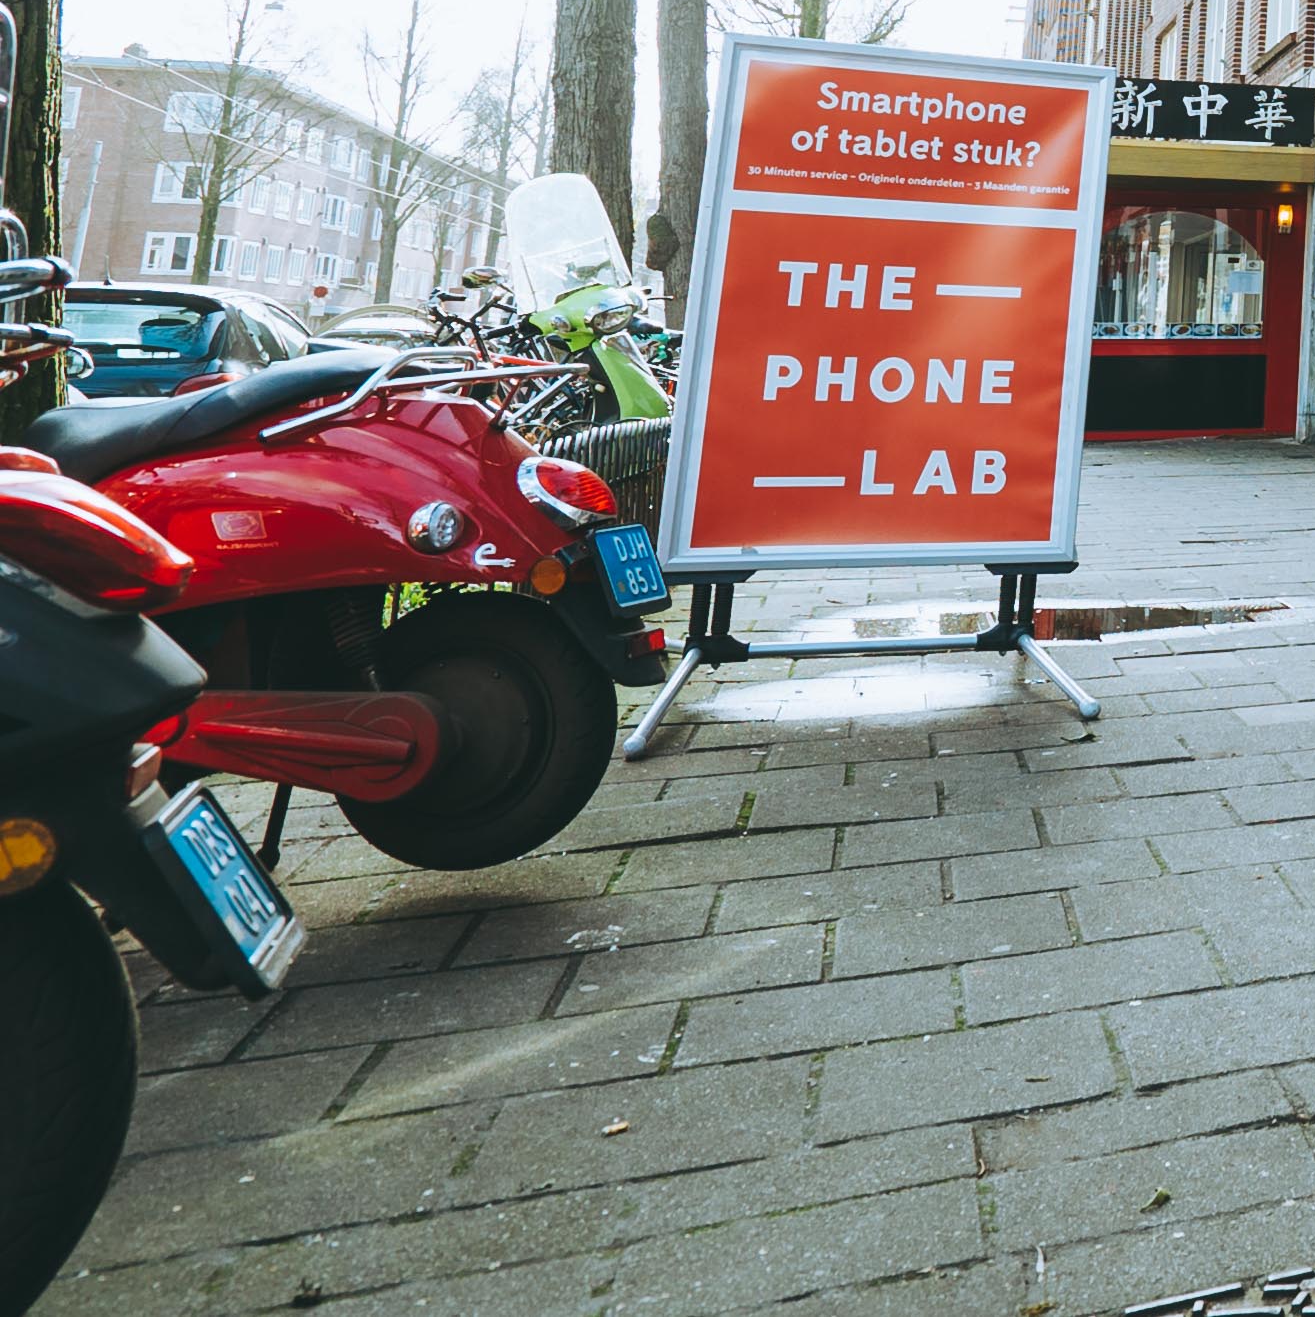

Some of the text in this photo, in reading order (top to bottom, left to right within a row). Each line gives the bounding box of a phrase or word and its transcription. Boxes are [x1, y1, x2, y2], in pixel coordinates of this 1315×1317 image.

[817, 81, 1026, 125] Smartphone
[1112, 79, 1295, 140] 新中華
[791, 125, 1042, 168] of tablet stuk?
[747, 165, 762, 175] 30
[764, 166, 807, 178] Minuten
[810, 170, 848, 180] service
[858, 172, 905, 185] Originele
[908, 176, 964, 188] onderdelen
[983, 181, 1028, 192] Maanden
[1029, 184, 1070, 195] garantie
[778, 259, 916, 311] THE
[762, 354, 1015, 405] PHONE
[859, 449, 1008, 496] LAB
[613, 531, 649, 562] DJH
[181, 810, 237, 876] DBS
